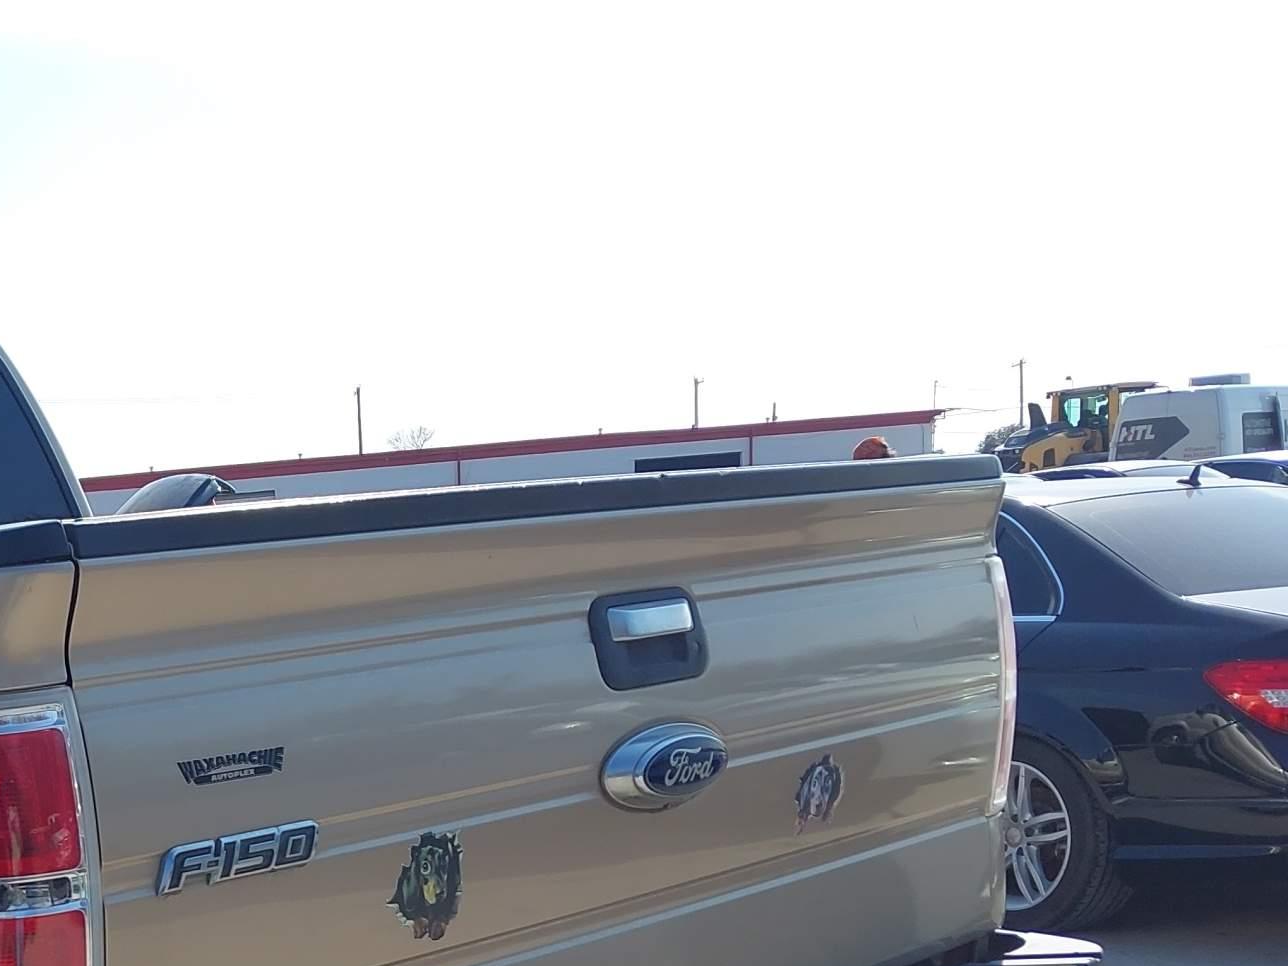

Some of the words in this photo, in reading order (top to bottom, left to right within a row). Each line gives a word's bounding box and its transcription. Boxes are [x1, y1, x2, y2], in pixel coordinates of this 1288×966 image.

[176, 746, 285, 785] WAXAHACHIE
[211, 768, 256, 782] AUTOPLEX
[665, 747, 715, 787] Ford
[158, 821, 319, 895] F-150
